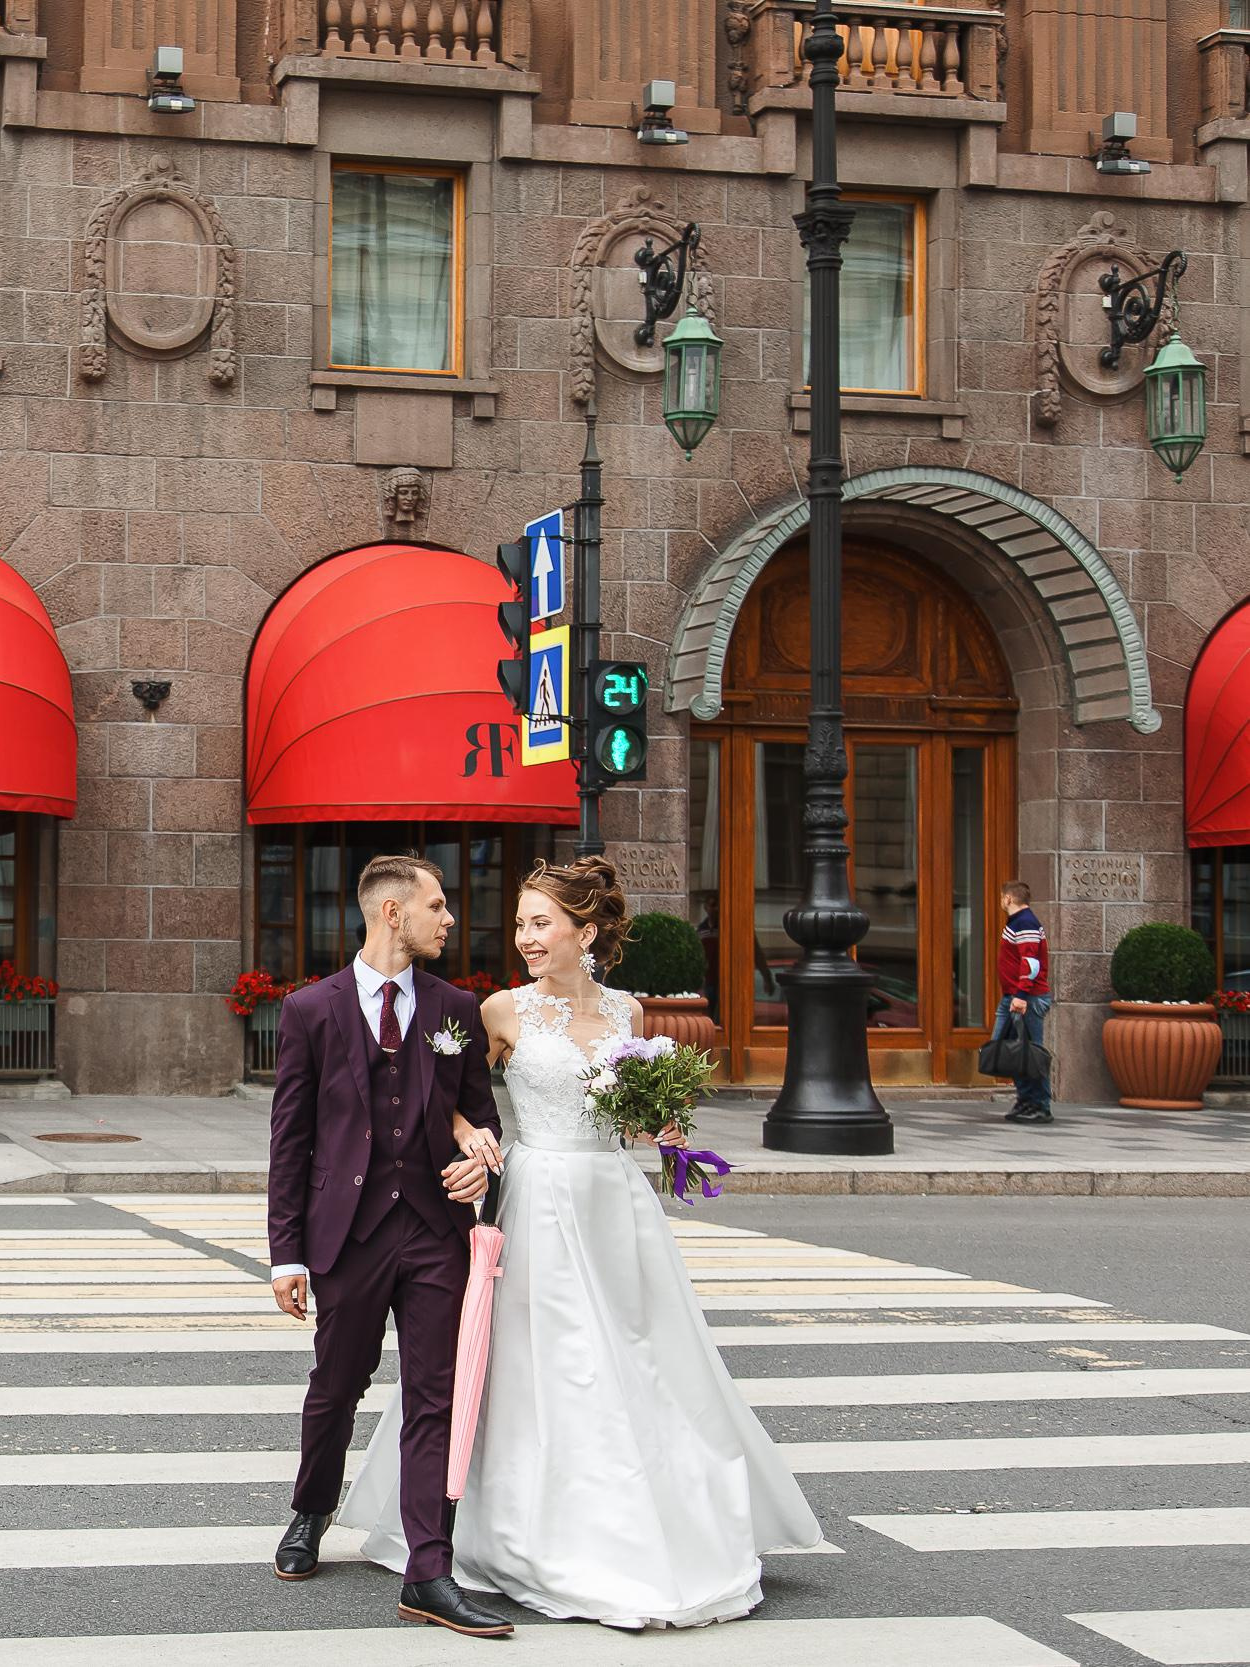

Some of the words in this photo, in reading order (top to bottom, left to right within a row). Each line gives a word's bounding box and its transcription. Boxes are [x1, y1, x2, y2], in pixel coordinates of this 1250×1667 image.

[604, 674, 638, 706] 24
[620, 846, 667, 860] HOTEL
[618, 861, 679, 877] STORIA
